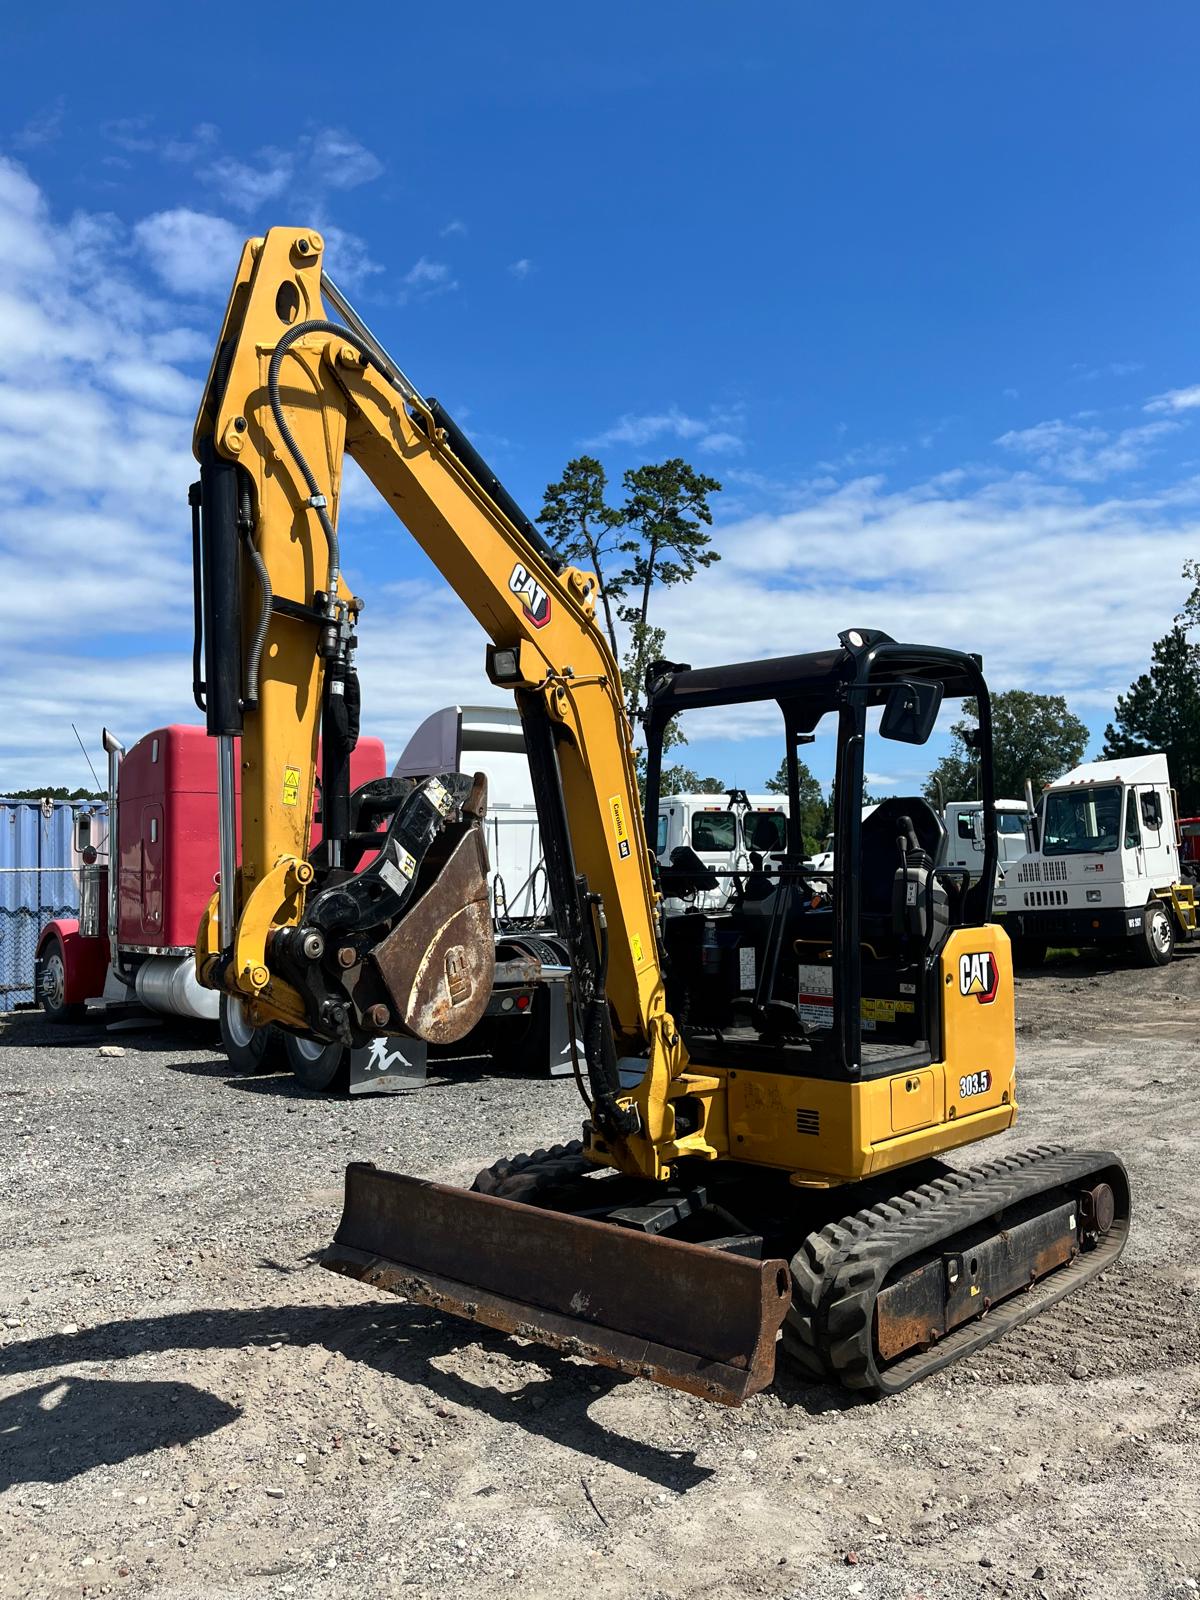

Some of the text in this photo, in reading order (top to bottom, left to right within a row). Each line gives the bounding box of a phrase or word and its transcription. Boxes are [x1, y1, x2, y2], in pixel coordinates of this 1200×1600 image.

[509, 563, 548, 616] CAT
[613, 803, 629, 856] Carolina CAT
[960, 953, 990, 995] CAT
[959, 1070, 989, 1098] 303.5
